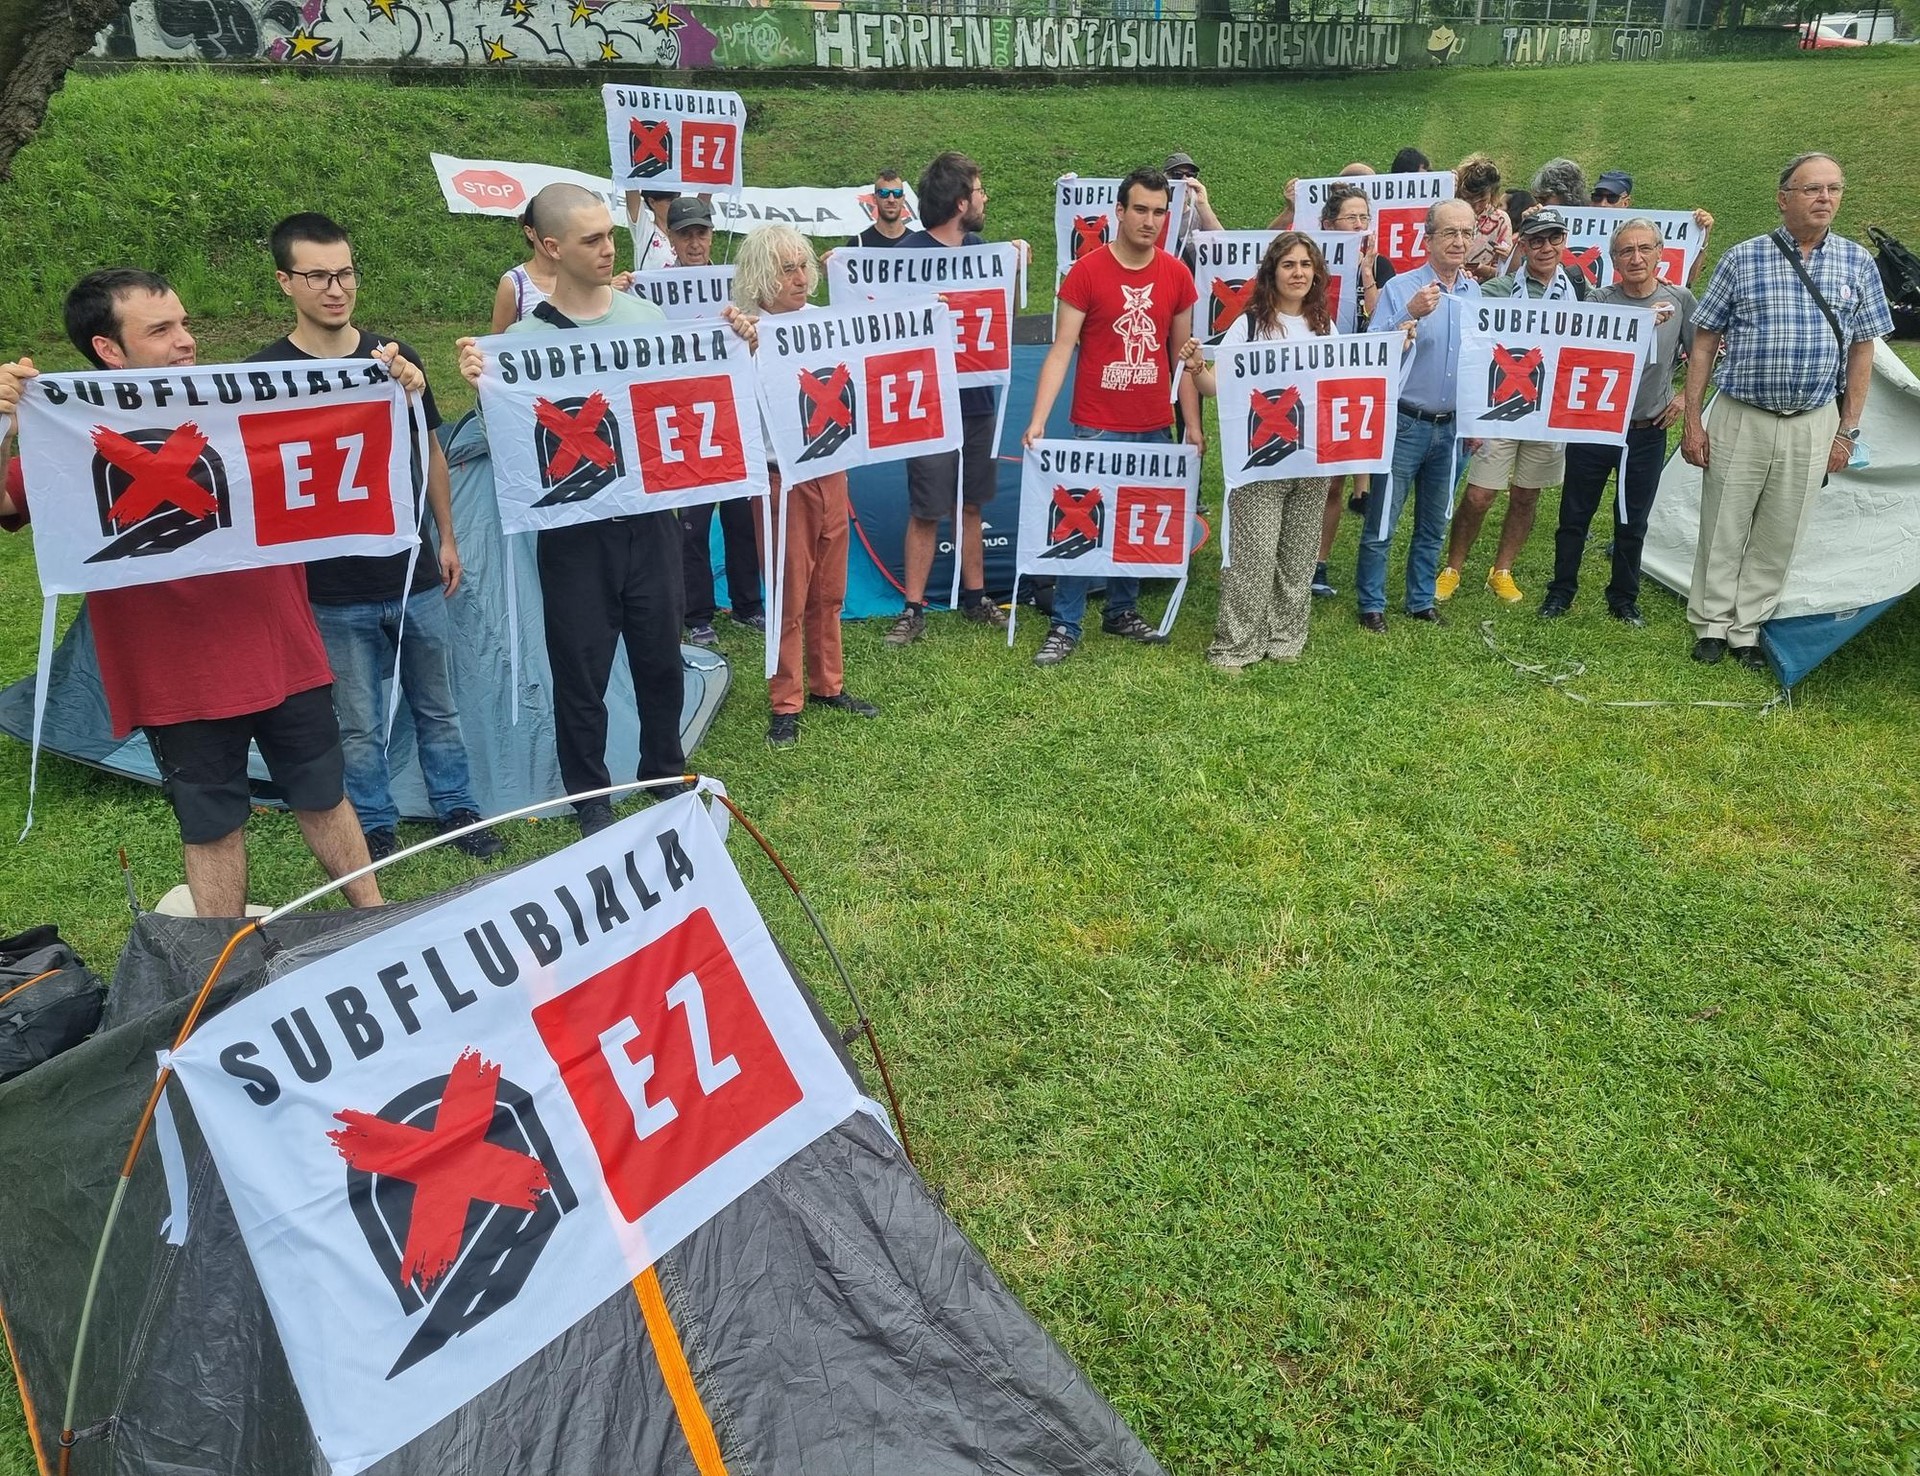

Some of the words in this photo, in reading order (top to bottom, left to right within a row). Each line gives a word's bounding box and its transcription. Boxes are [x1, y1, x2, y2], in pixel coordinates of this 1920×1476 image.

[814, 12, 991, 67] HERRIEN
[1015, 17, 1196, 68] NORTASUNA
[1218, 22, 1400, 68] BERRESKURATU
[616, 89, 739, 118] SUBFLUBIALA
[692, 135, 727, 169] EZ
[462, 179, 515, 199] STOP
[1309, 178, 1441, 204] SUUBIALA
[1198, 242, 1345, 266] SUBFLLA
[1389, 222, 1426, 259] EZ
[847, 252, 1004, 284] SUBFLUBIALA
[776, 308, 935, 357] SUBFLUBIALA
[947, 307, 995, 354] EZ
[1478, 307, 1639, 343] SUBFLUBIALA
[498, 329, 729, 385] SUBFLUBIALA
[1234, 341, 1389, 378] SUBFLUBIALA
[42, 362, 392, 411] SUBFLUBIALA
[879, 369, 927, 424] EZ
[1566, 366, 1619, 412] EZ
[656, 400, 723, 464] EZ
[1331, 395, 1375, 443] EZ
[278, 432, 369, 511] EZ
[1040, 449, 1187, 479] SUBFLUBIALA
[1128, 503, 1173, 546] EZ
[218, 828, 695, 1107] SUBFLUBIALA
[598, 971, 743, 1142] EZ
